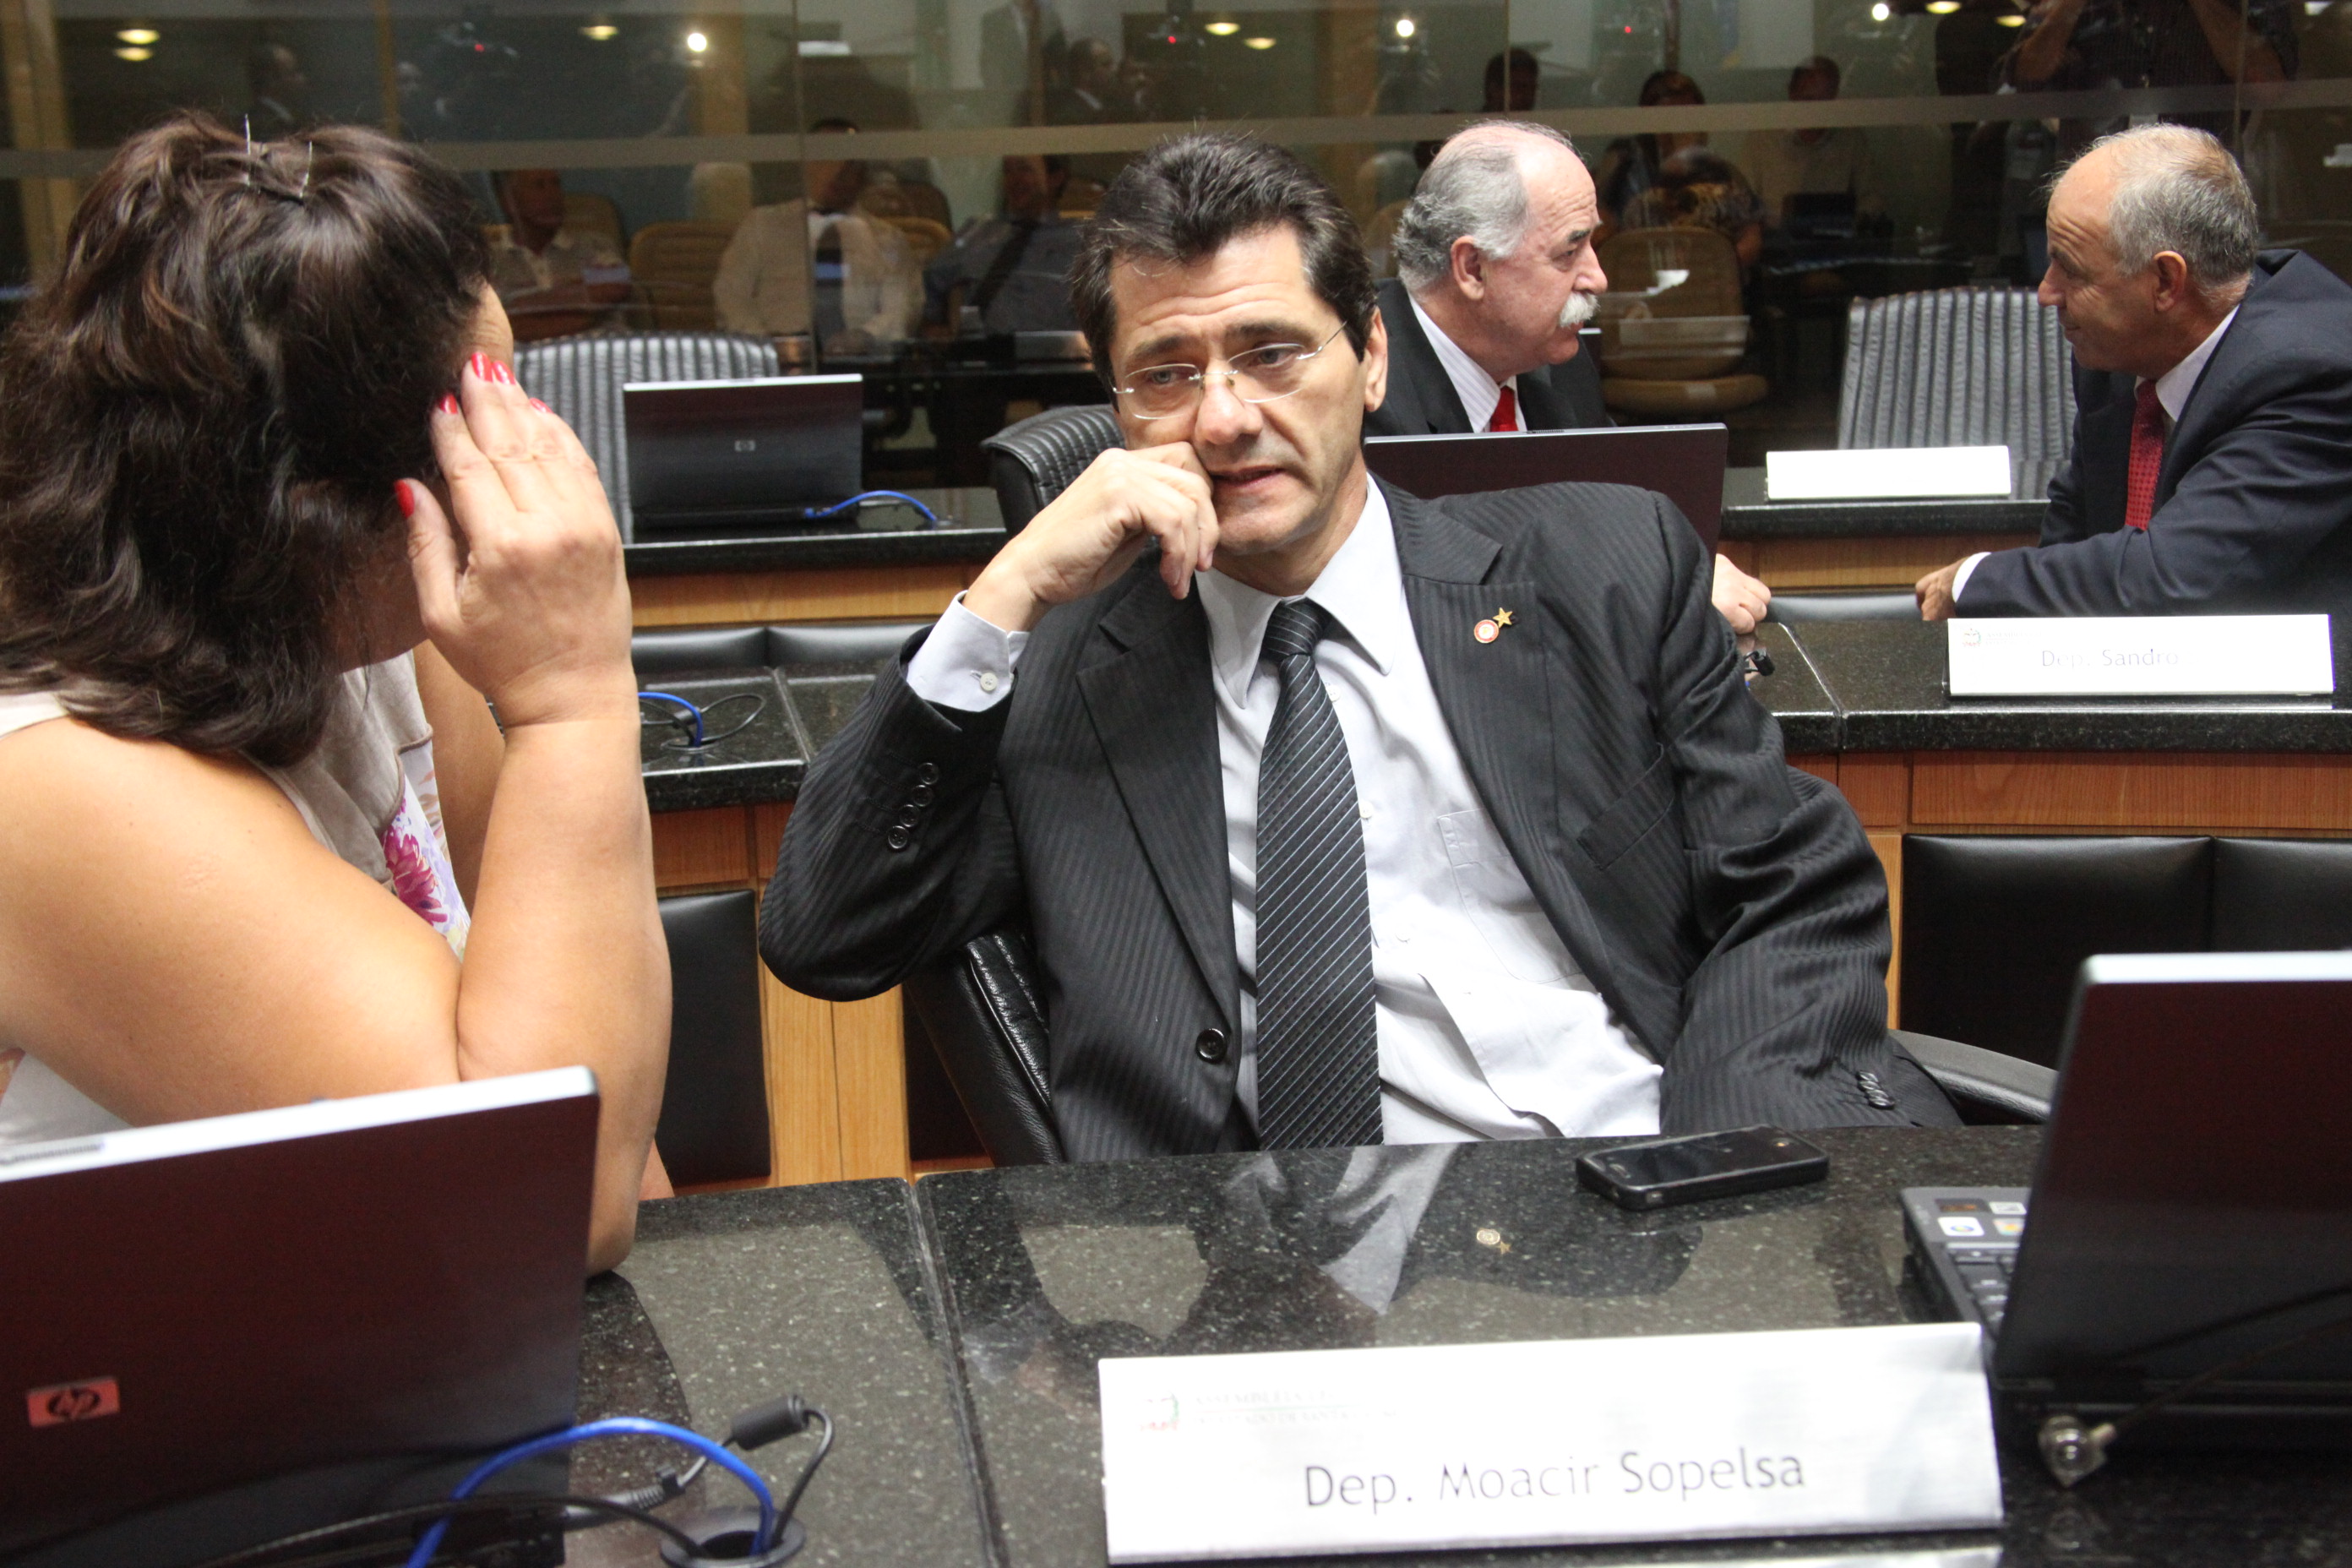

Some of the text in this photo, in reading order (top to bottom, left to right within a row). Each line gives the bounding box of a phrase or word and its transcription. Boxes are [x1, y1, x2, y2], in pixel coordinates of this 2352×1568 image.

[2042, 648, 2179, 670] Dep. Sandro
[1304, 1446, 1805, 1515] Dep. Moacir Sopelsa
